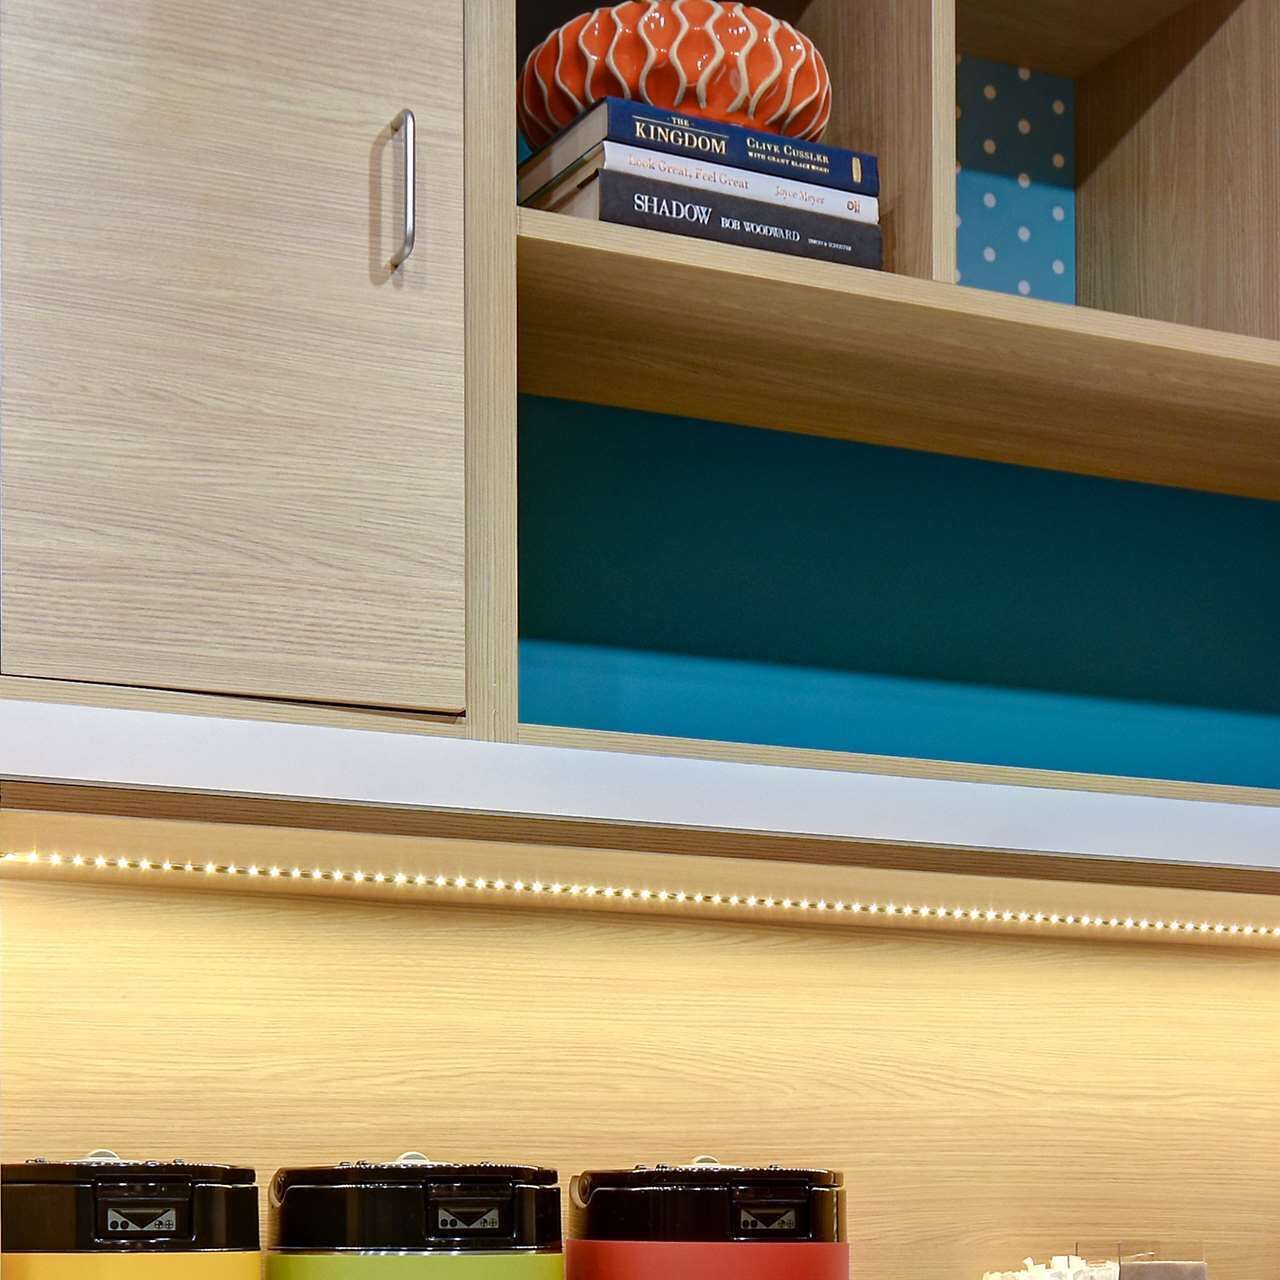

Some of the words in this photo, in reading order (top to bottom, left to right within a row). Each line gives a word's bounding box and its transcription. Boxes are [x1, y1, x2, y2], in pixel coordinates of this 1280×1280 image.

[671, 116, 690, 128] THE
[634, 121, 726, 155] KINGDOM
[746, 137, 780, 153] CLIVE
[783, 145, 829, 164] CUSSLER
[659, 160, 693, 178] Great,
[695, 168, 716, 183] Feel
[719, 173, 749, 190] Great
[633, 193, 713, 226] SHADOW
[721, 216, 741, 231] BOB
[742, 221, 800, 242] WOODWARD
